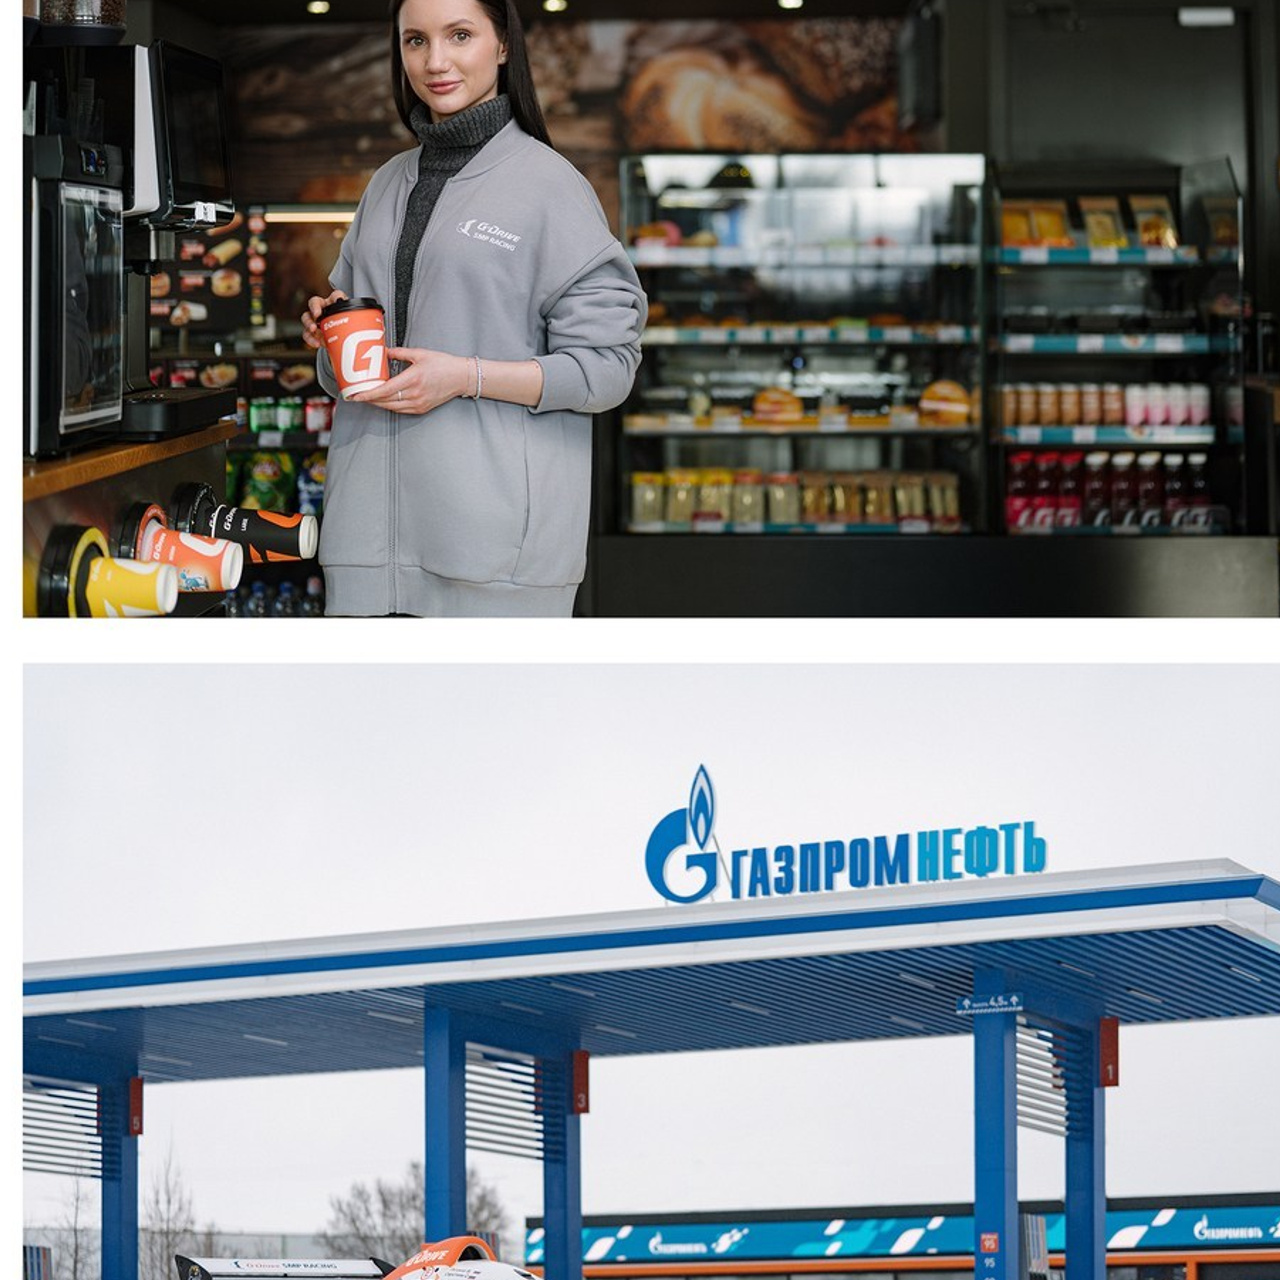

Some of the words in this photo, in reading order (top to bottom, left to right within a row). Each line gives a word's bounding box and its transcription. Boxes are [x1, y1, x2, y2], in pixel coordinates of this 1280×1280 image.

[476, 221, 522, 243] G-DRIVE
[473, 232, 490, 242] SMP
[489, 237, 517, 252] RACING
[1106, 1064, 1113, 1080] 1
[577, 1093, 586, 1108] 3
[132, 1117, 140, 1131] 5
[303, 1261, 338, 1269] RACING
[983, 1257, 996, 1269] 95
